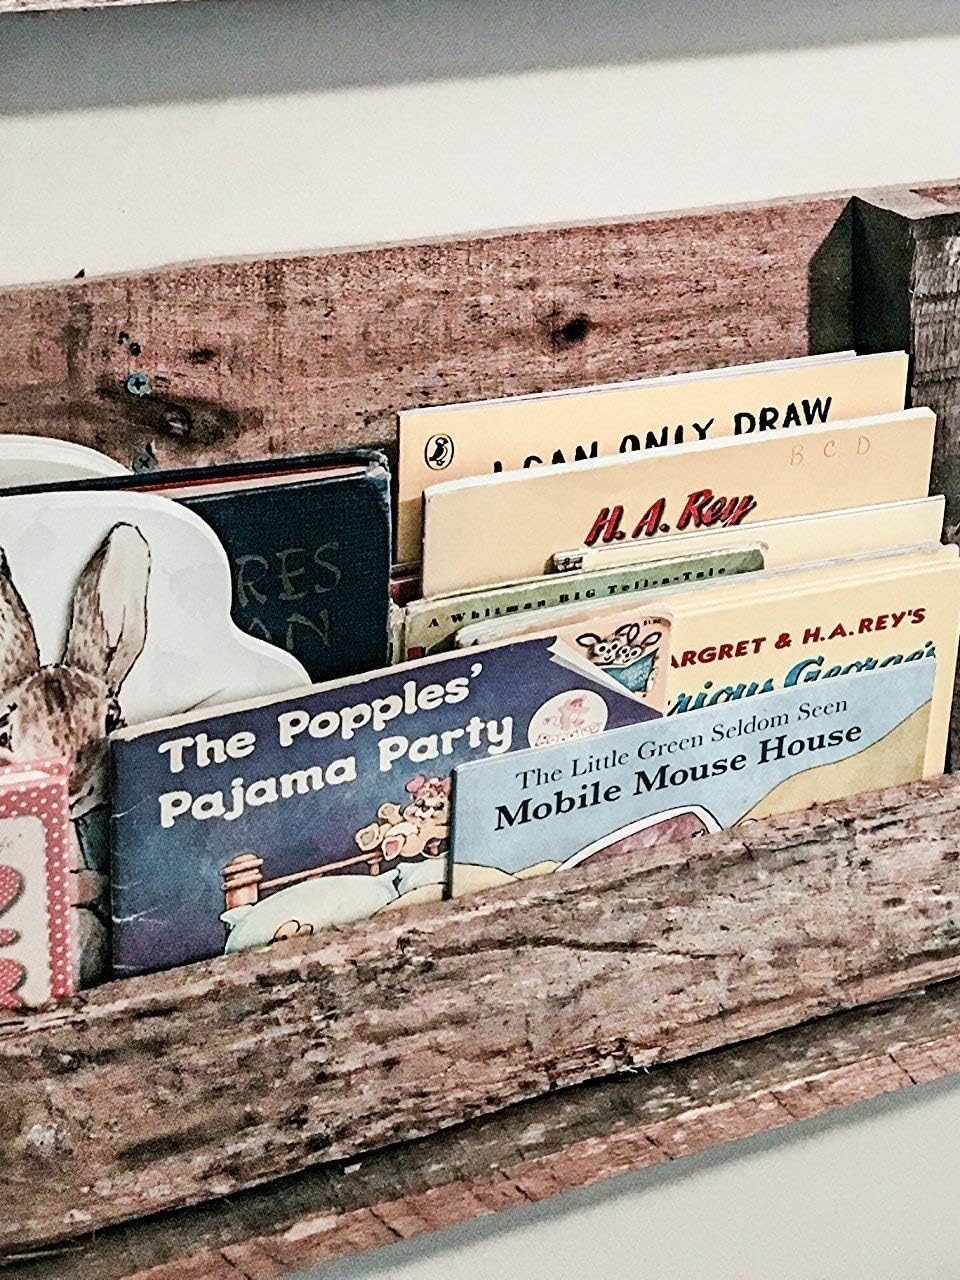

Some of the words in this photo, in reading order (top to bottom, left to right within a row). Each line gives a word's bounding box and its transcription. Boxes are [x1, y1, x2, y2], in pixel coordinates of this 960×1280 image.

[619, 418, 714, 454] ONLY
[734, 396, 832, 436] DRAW
[789, 444, 804, 466] B
[823, 439, 838, 457] C
[855, 435, 871, 455] D
[676, 488, 757, 531] Rey
[428, 618, 439, 628] A
[450, 599, 547, 624] Whitman
[559, 588, 596, 603] BIG
[607, 566, 727, 595] Tell-a-Tale
[774, 632, 792, 650] &
[158, 729, 256, 774] The
[277, 663, 483, 749] Popples'
[516, 768, 562, 790] The
[571, 748, 630, 778] Little
[636, 734, 705, 761] Green
[711, 710, 790, 743] Seldom
[797, 696, 848, 722] Seen
[159, 755, 357, 828] Pajama
[378, 714, 513, 772] Party
[494, 781, 622, 831] Mobile
[632, 751, 748, 796] Mouse
[756, 722, 862, 764] House
